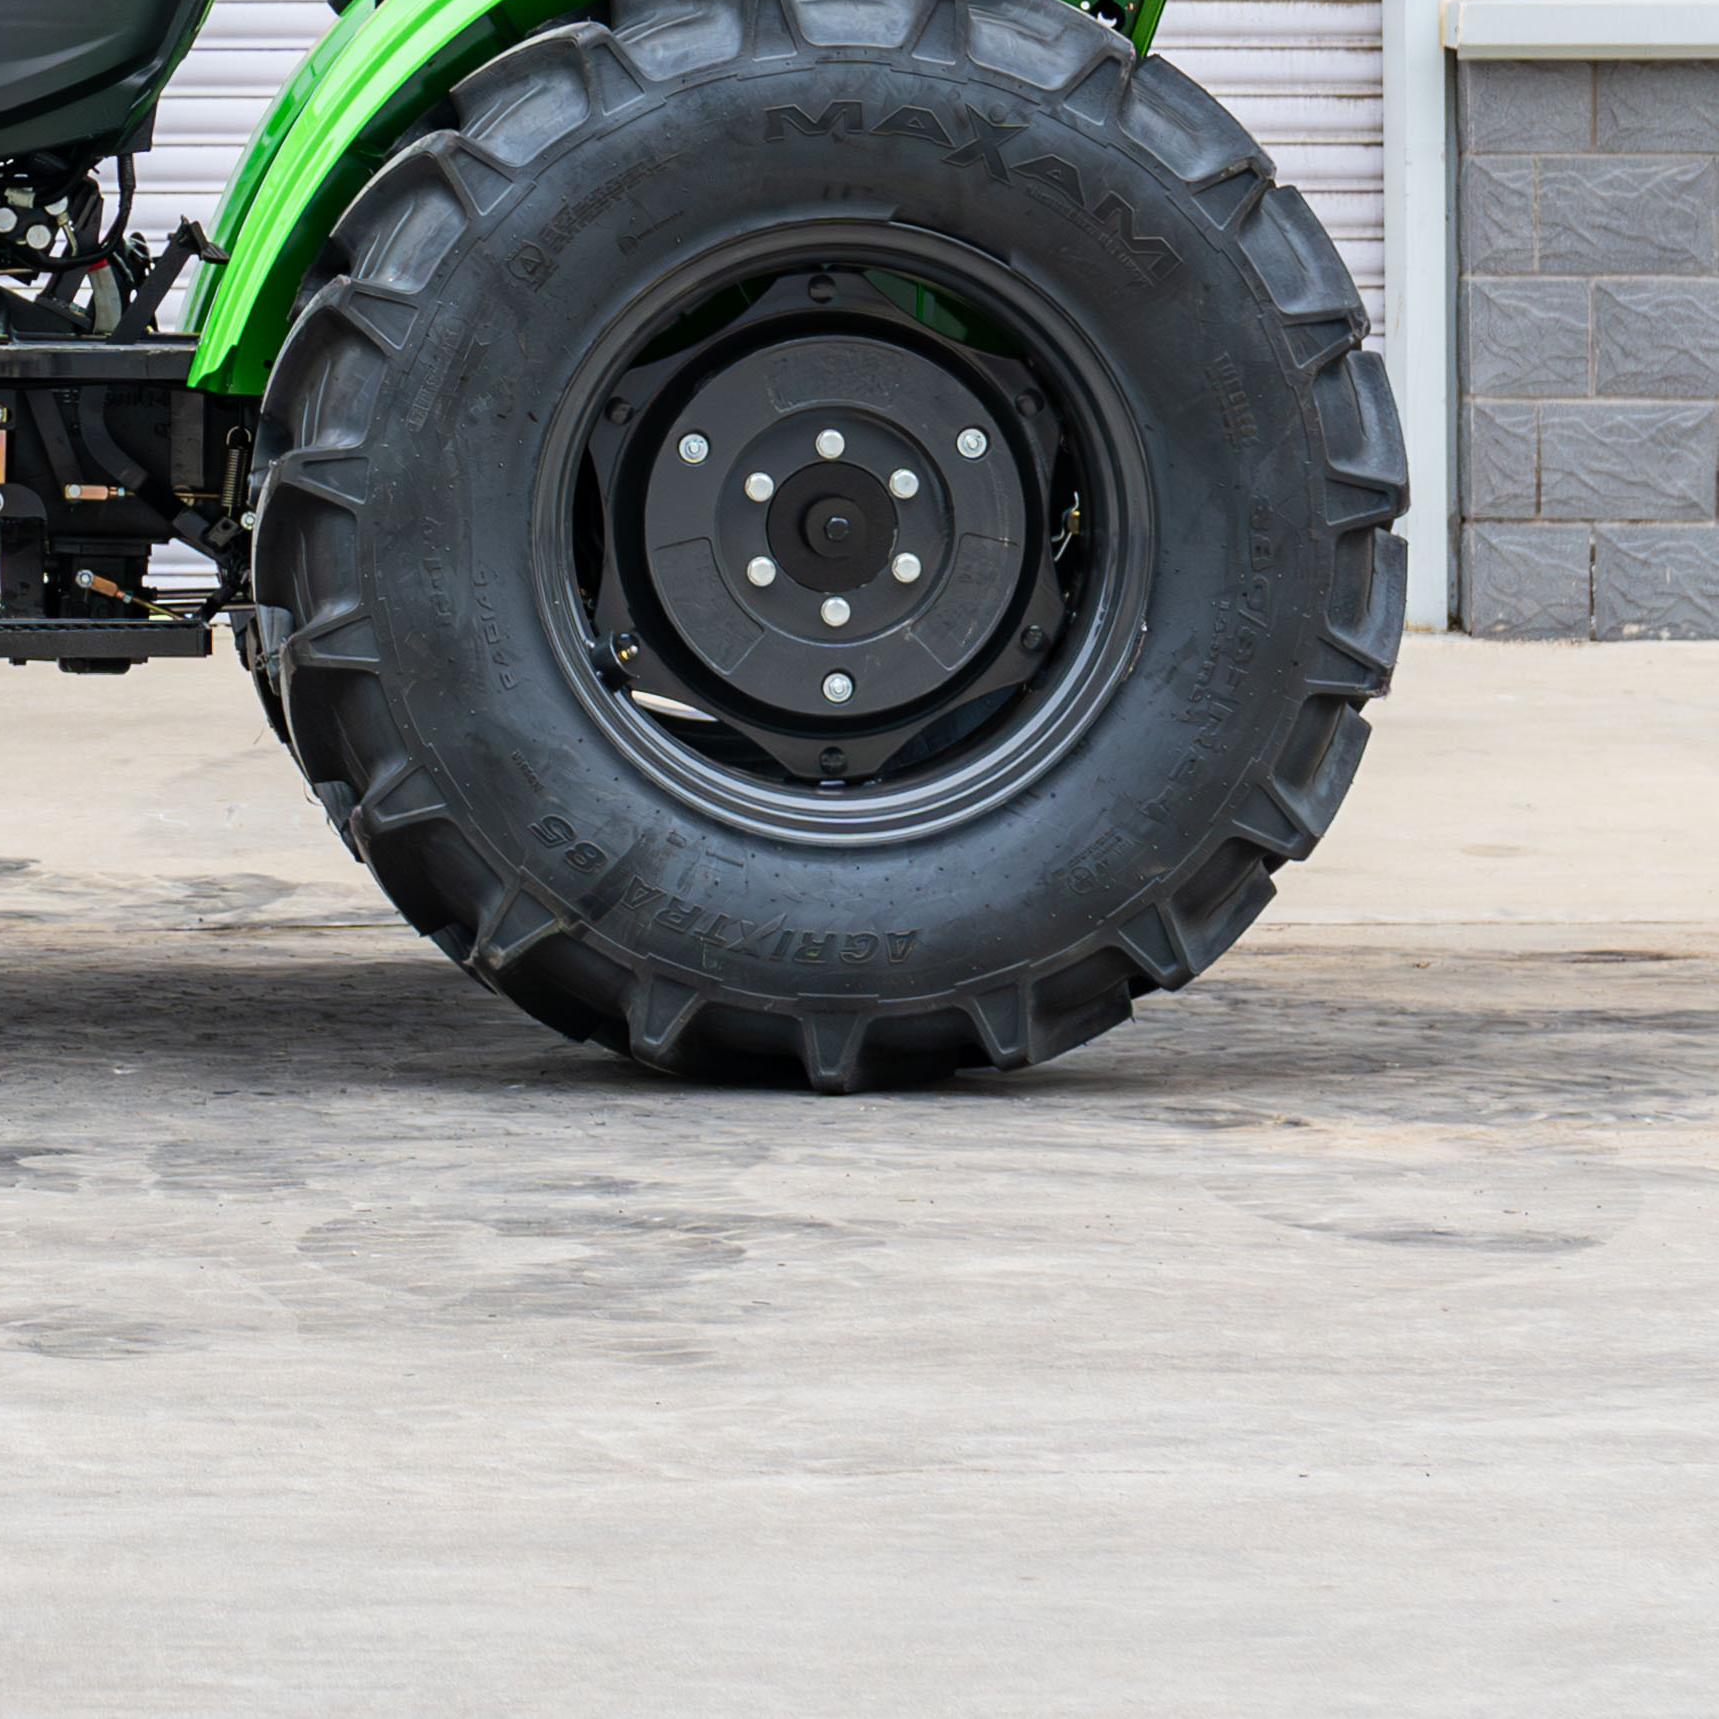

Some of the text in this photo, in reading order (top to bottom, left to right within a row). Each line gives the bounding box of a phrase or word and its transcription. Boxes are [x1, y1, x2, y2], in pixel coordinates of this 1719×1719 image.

[765, 101, 1183, 275] MAXAM
[529, 814, 923, 966] AGRIXTRA 85
